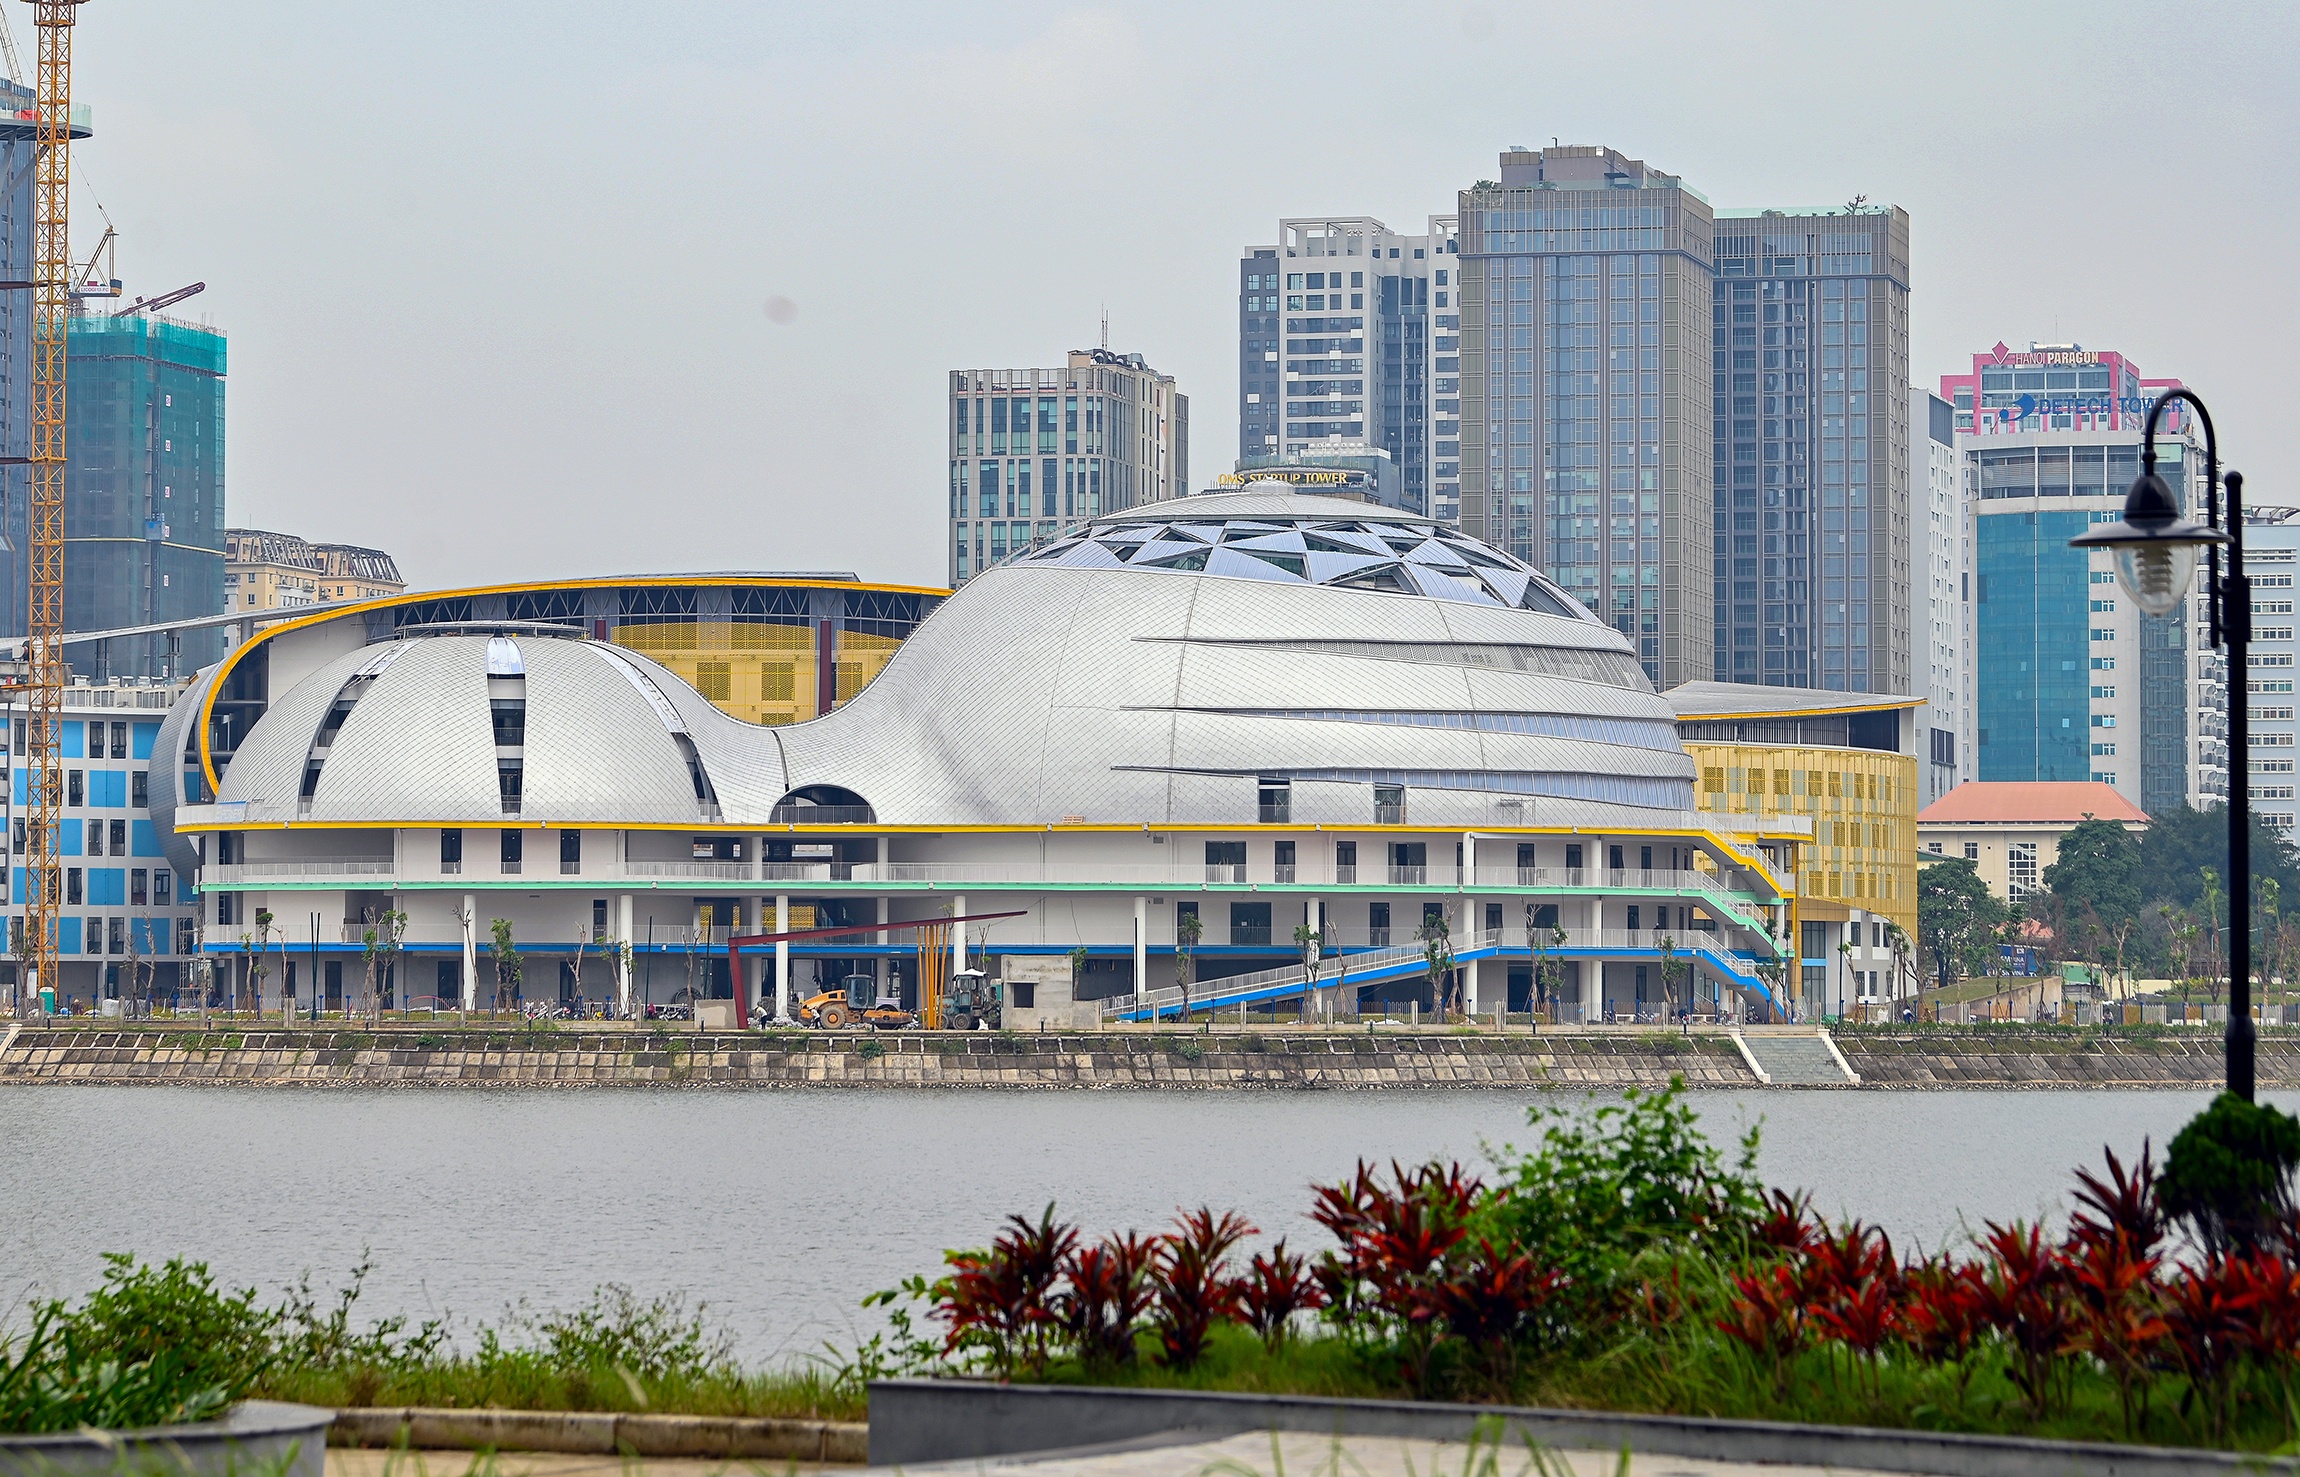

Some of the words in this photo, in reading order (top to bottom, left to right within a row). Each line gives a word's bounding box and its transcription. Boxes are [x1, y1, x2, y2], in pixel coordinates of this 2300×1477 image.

[2015, 352, 2046, 364] HANOI
[2047, 351, 2099, 364] PARAGON
[2039, 397, 2112, 414] DETECH
[1304, 471, 1348, 484] TOWER
